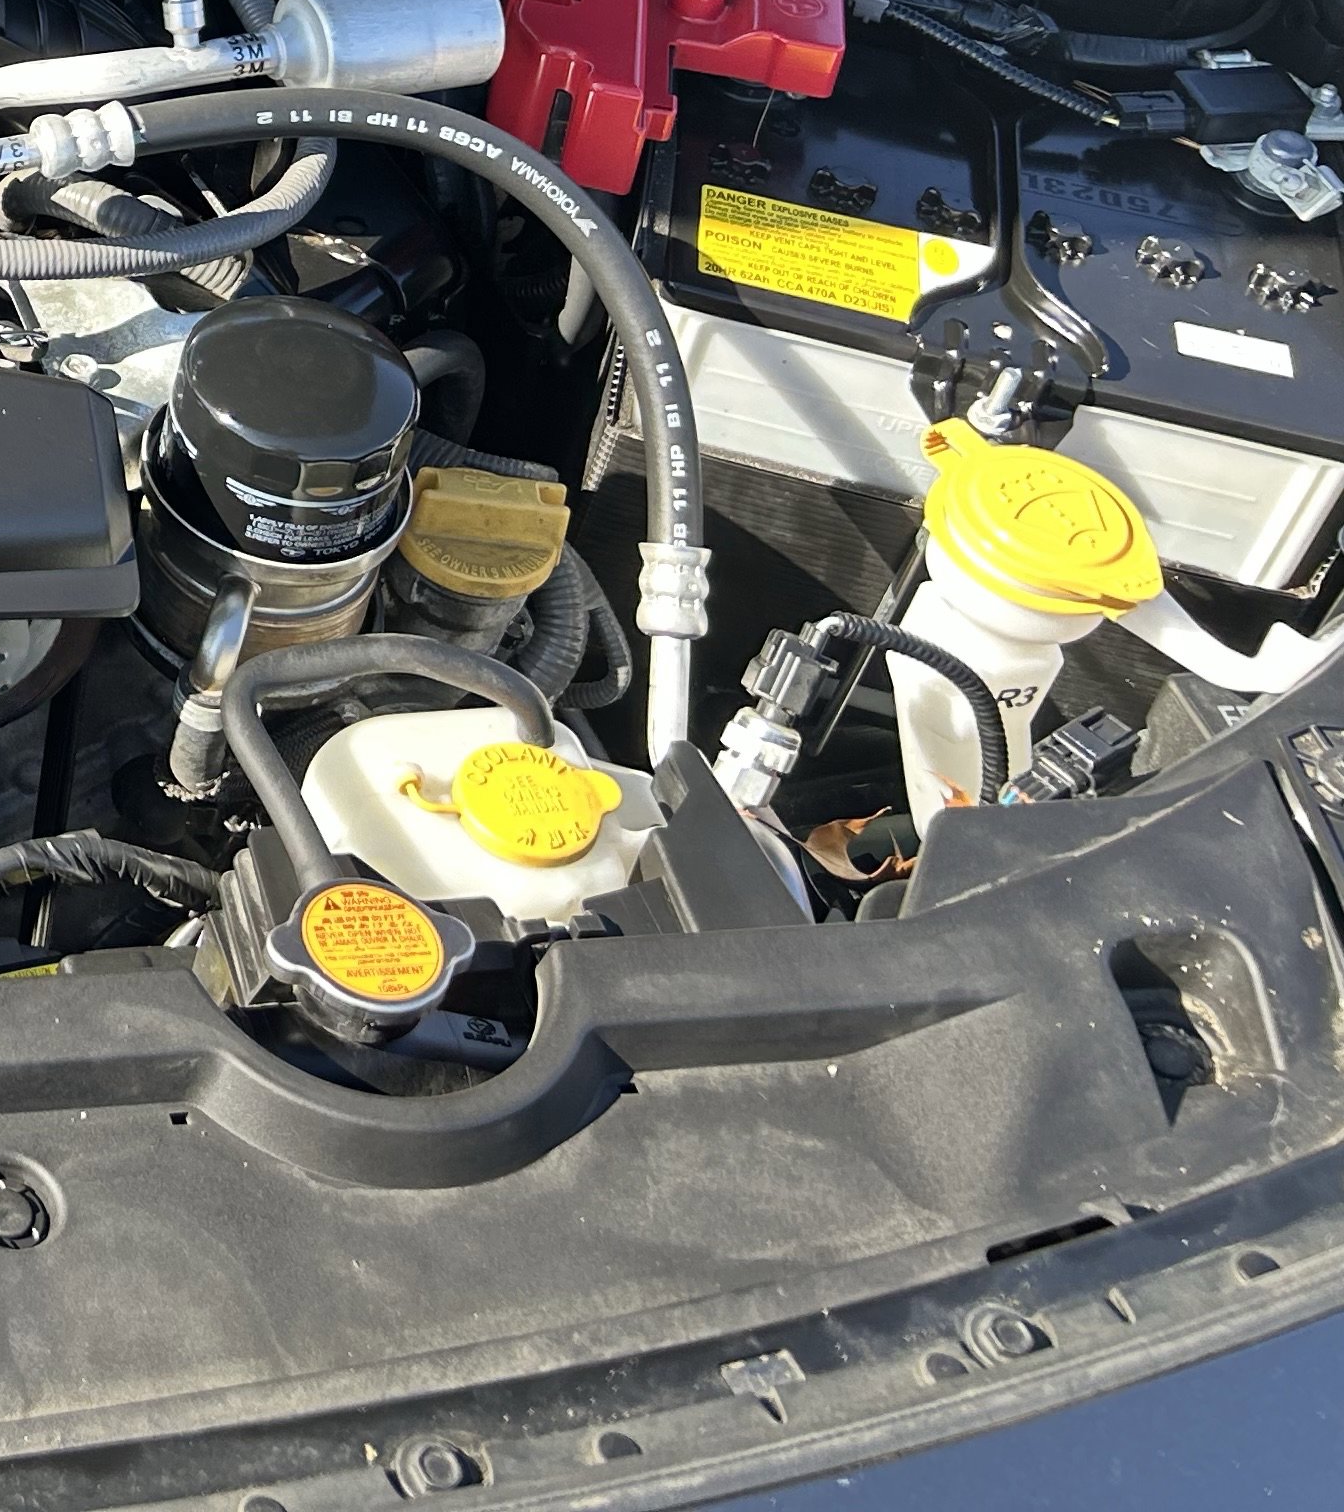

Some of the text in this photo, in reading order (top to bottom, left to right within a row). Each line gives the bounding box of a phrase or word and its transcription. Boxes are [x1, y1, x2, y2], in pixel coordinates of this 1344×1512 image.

[256, 111, 273, 125] 2
[289, 109, 312, 123] 11
[366, 112, 399, 128] HP
[406, 117, 428, 134] 11
[510, 156, 580, 219] YOKOHAMA
[706, 188, 766, 209] DANGER
[772, 204, 818, 221] EXPLOSIVE
[820, 214, 849, 227] GASES
[705, 230, 762, 250] POISON
[749, 230, 897, 271] KEEP VENT CAPS TIGHT AND LEVEL
[771, 247, 874, 275] CAUSES SEVERE BURNS
[704, 261, 736, 278] 20HR
[740, 270, 770, 284] 62Ah
[777, 279, 804, 294] CCA
[807, 285, 837, 300] 470A
[748, 262, 897, 304] KEEP OUT OF REACH OF CHILDREN
[645, 328, 662, 347] 2
[655, 362, 673, 387] 11
[670, 444, 685, 477] HP
[673, 488, 687, 511] 11
[313, 540, 360, 556] TOKYO
[417, 537, 548, 579] SEE OWNER'S MANUAL
[342, 896, 392, 906] WARNING
